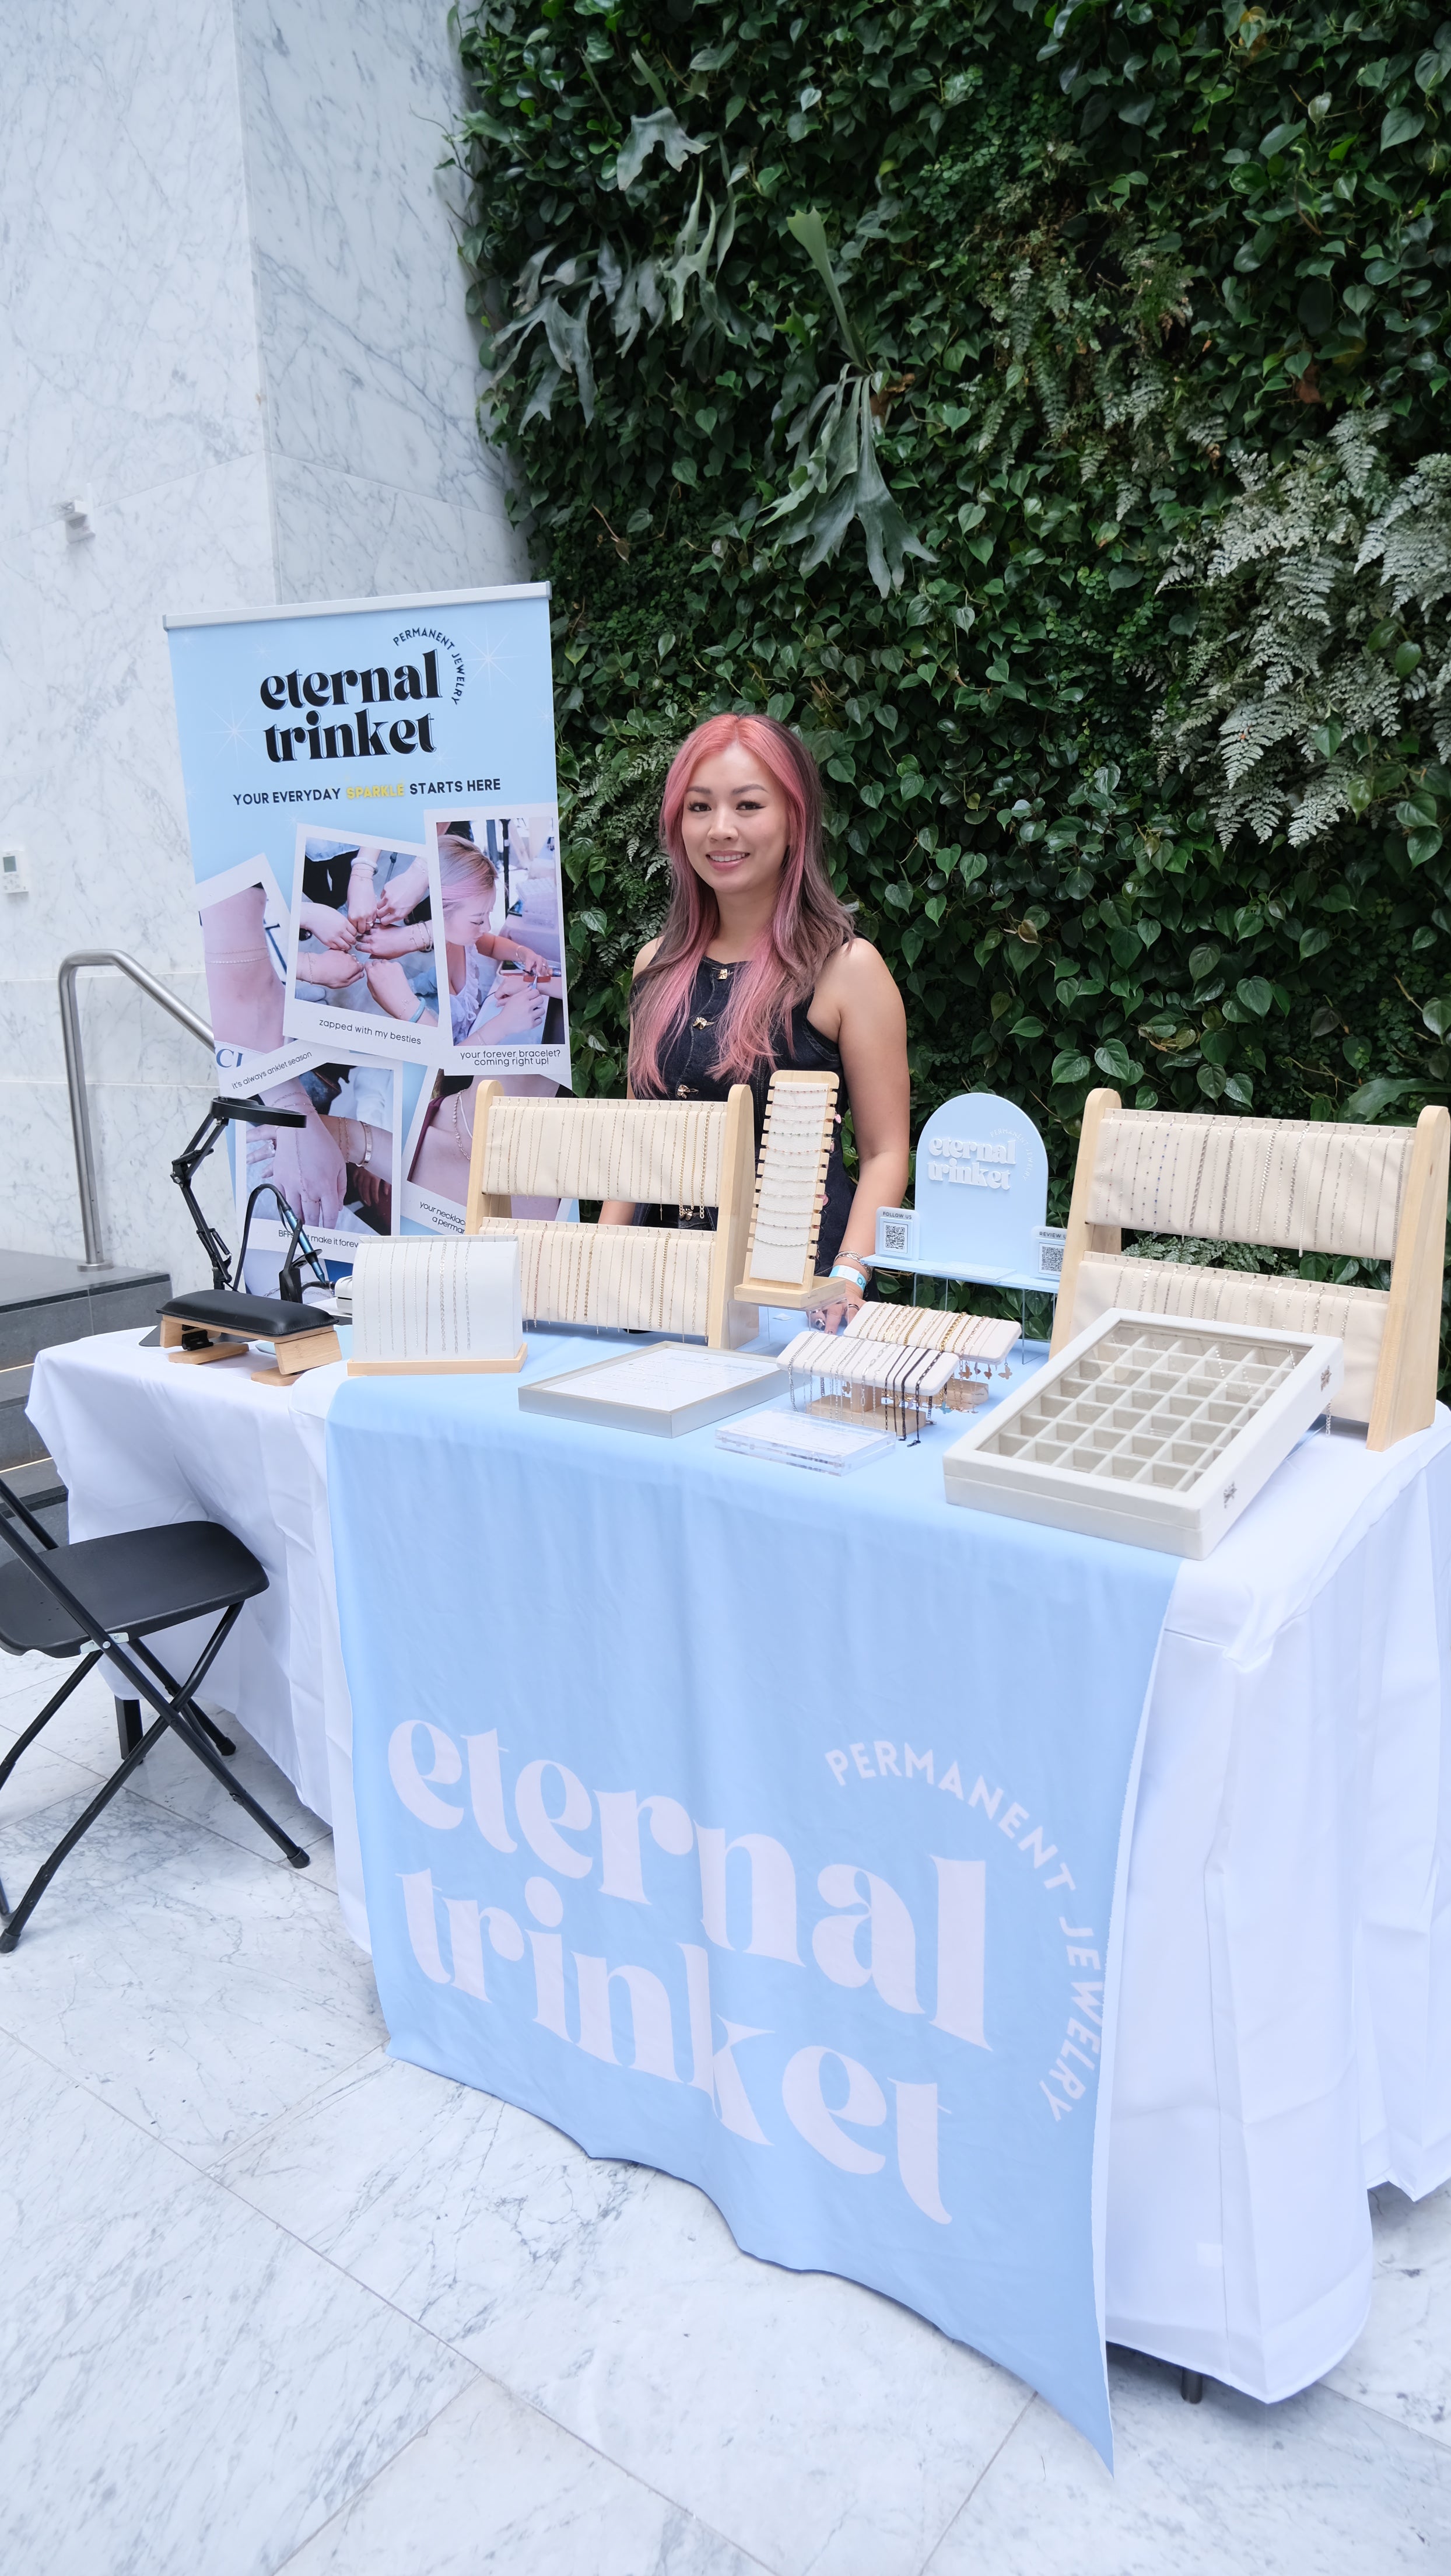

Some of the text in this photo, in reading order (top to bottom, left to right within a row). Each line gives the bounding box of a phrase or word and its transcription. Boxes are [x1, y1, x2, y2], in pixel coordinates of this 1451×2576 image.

[260, 649, 443, 710] eternal
[392, 628, 465, 705] PERMANENT JEWELRY
[262, 708, 437, 763] trinket
[233, 778, 501, 806] YOUR EVERYDAY SPARKLE STARTS HERE
[319, 1019, 422, 1045] zapped with my besties
[232, 1051, 313, 1090] it's always anklet season
[460, 1049, 561, 1060] your forever bracelet?
[474, 1057, 549, 1067] coming right up!
[928, 1138, 1017, 1165] eternal
[927, 1157, 1011, 1191] trinket
[419, 1201, 465, 1226] your necklac
[311, 1235, 332, 1244] make
[333, 1237, 338, 1245] it
[387, 1719, 994, 2052] eternal
[825, 1740, 1104, 2122] PERMANENT JEWELRY
[395, 1867, 952, 2225] trinket
